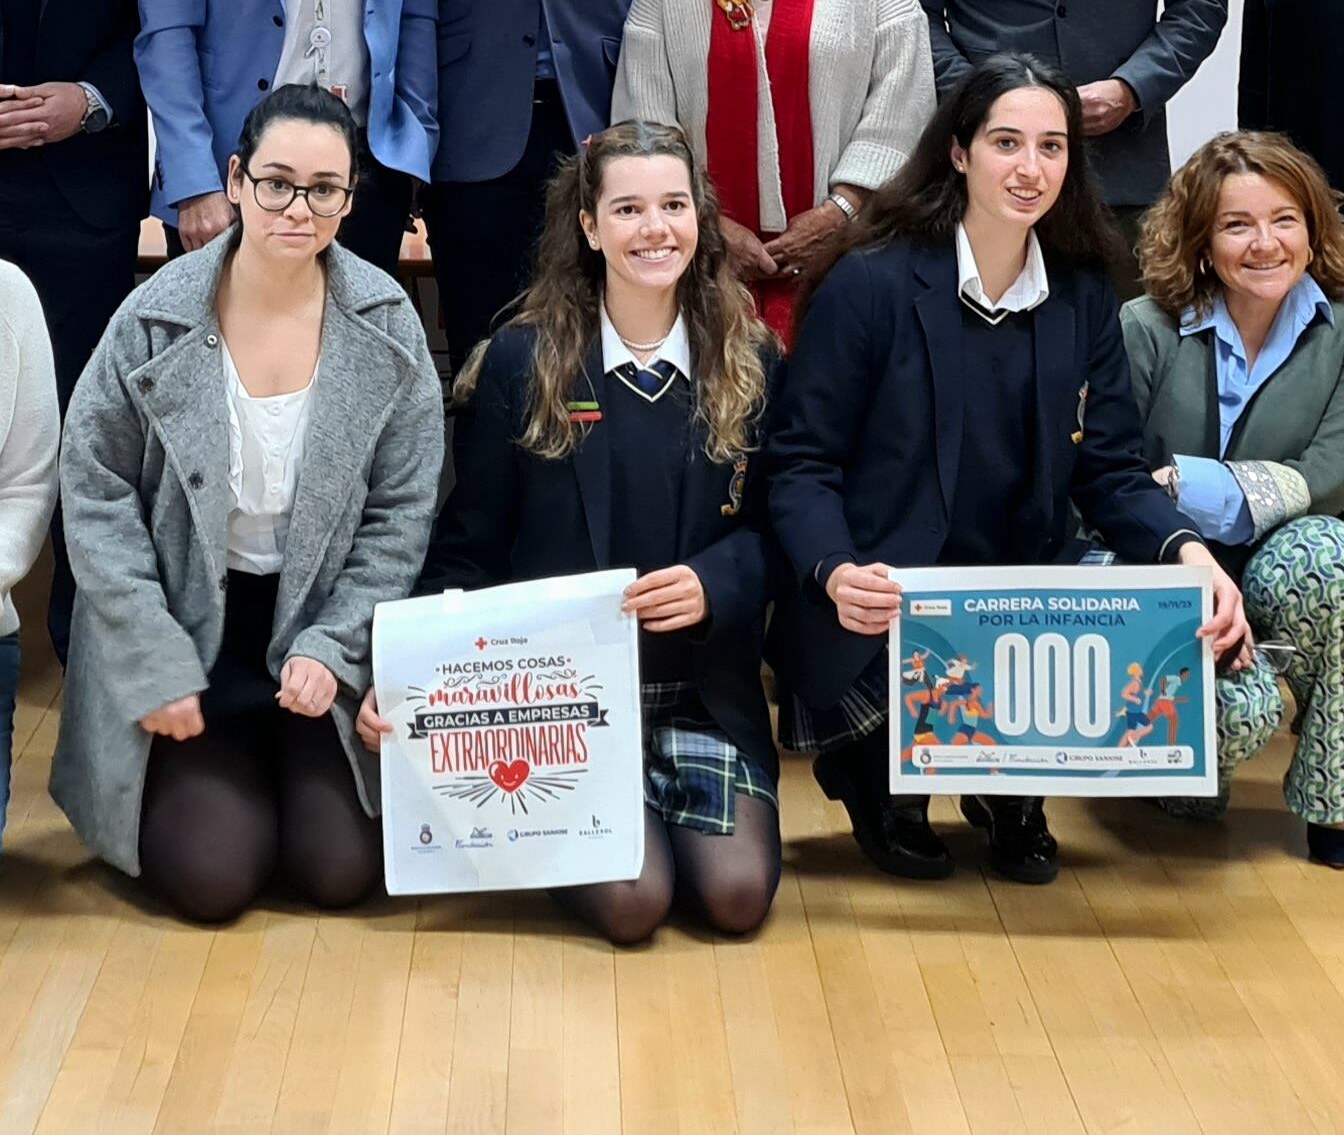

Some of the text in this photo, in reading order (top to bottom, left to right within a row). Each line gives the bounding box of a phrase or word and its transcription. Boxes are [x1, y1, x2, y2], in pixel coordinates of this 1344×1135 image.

[964, 597, 1140, 613] CARRERA SOLIDARIA
[979, 613, 1126, 627] POR LA INFANCIA
[511, 636, 528, 645] Roja
[442, 656, 566, 675] HACEMOS COSAS
[428, 672, 580, 706] maravillosas
[994, 632, 1111, 738] 000
[423, 704, 590, 728] GRACIAS A EMPRESAS
[430, 722, 589, 774] EXTRAORDINARIAS
